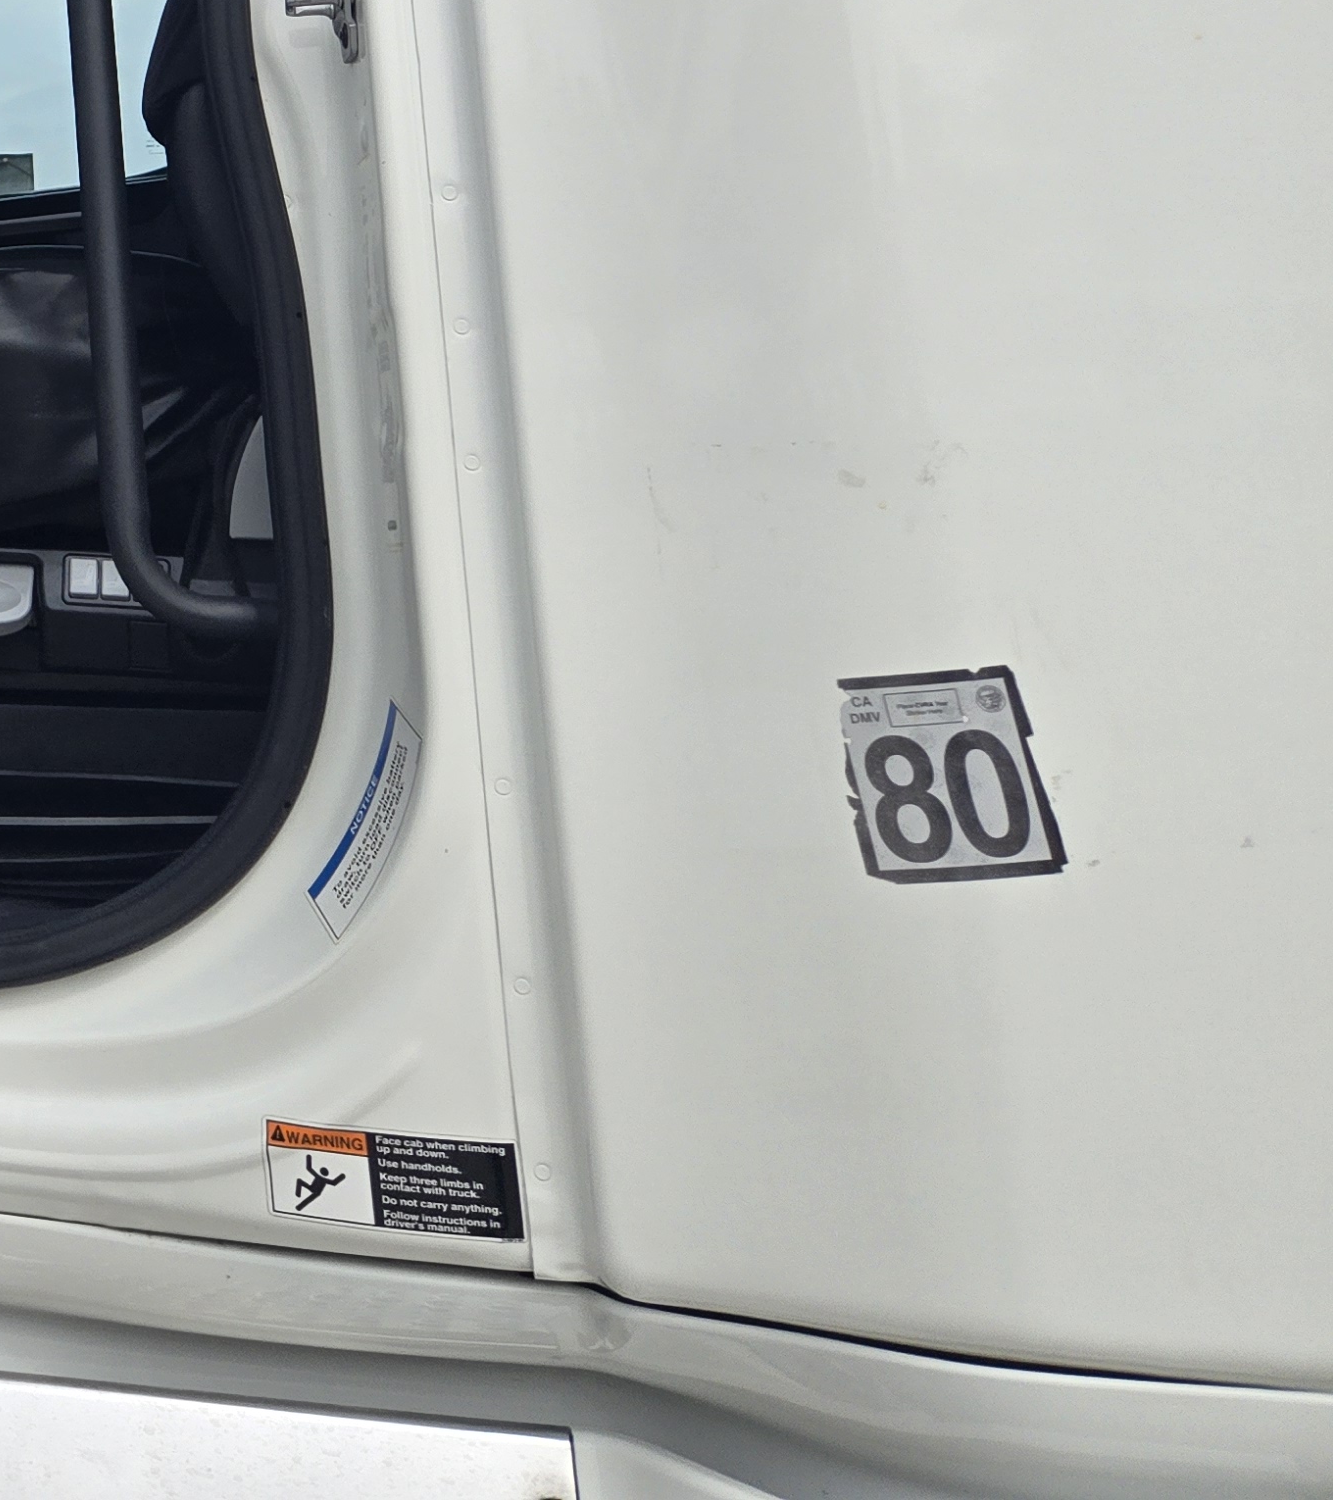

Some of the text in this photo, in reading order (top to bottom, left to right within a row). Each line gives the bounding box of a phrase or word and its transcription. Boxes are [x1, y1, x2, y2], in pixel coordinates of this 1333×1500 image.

[851, 696, 873, 708] CA
[849, 712, 880, 724] DMV
[351, 776, 378, 834] NOTICE
[865, 729, 1030, 863] 80
[370, 825, 382, 851] OFF
[355, 863, 372, 891] more
[372, 834, 386, 859] than
[386, 808, 396, 831] one
[344, 847, 362, 878] avoid
[286, 1130, 364, 1151] WARNING
[375, 1135, 505, 1156] Face cab when climbing
[376, 1145, 449, 1159] up and down.
[378, 1158, 462, 1174] Use handholds.
[379, 1172, 484, 1190] Keep three limbs in
[380, 1181, 481, 1199] contact with truck.
[382, 1195, 503, 1216] Do not carry anything.
[383, 1209, 501, 1229] Follow instructions in
[383, 1219, 471, 1234] driver's manual.
